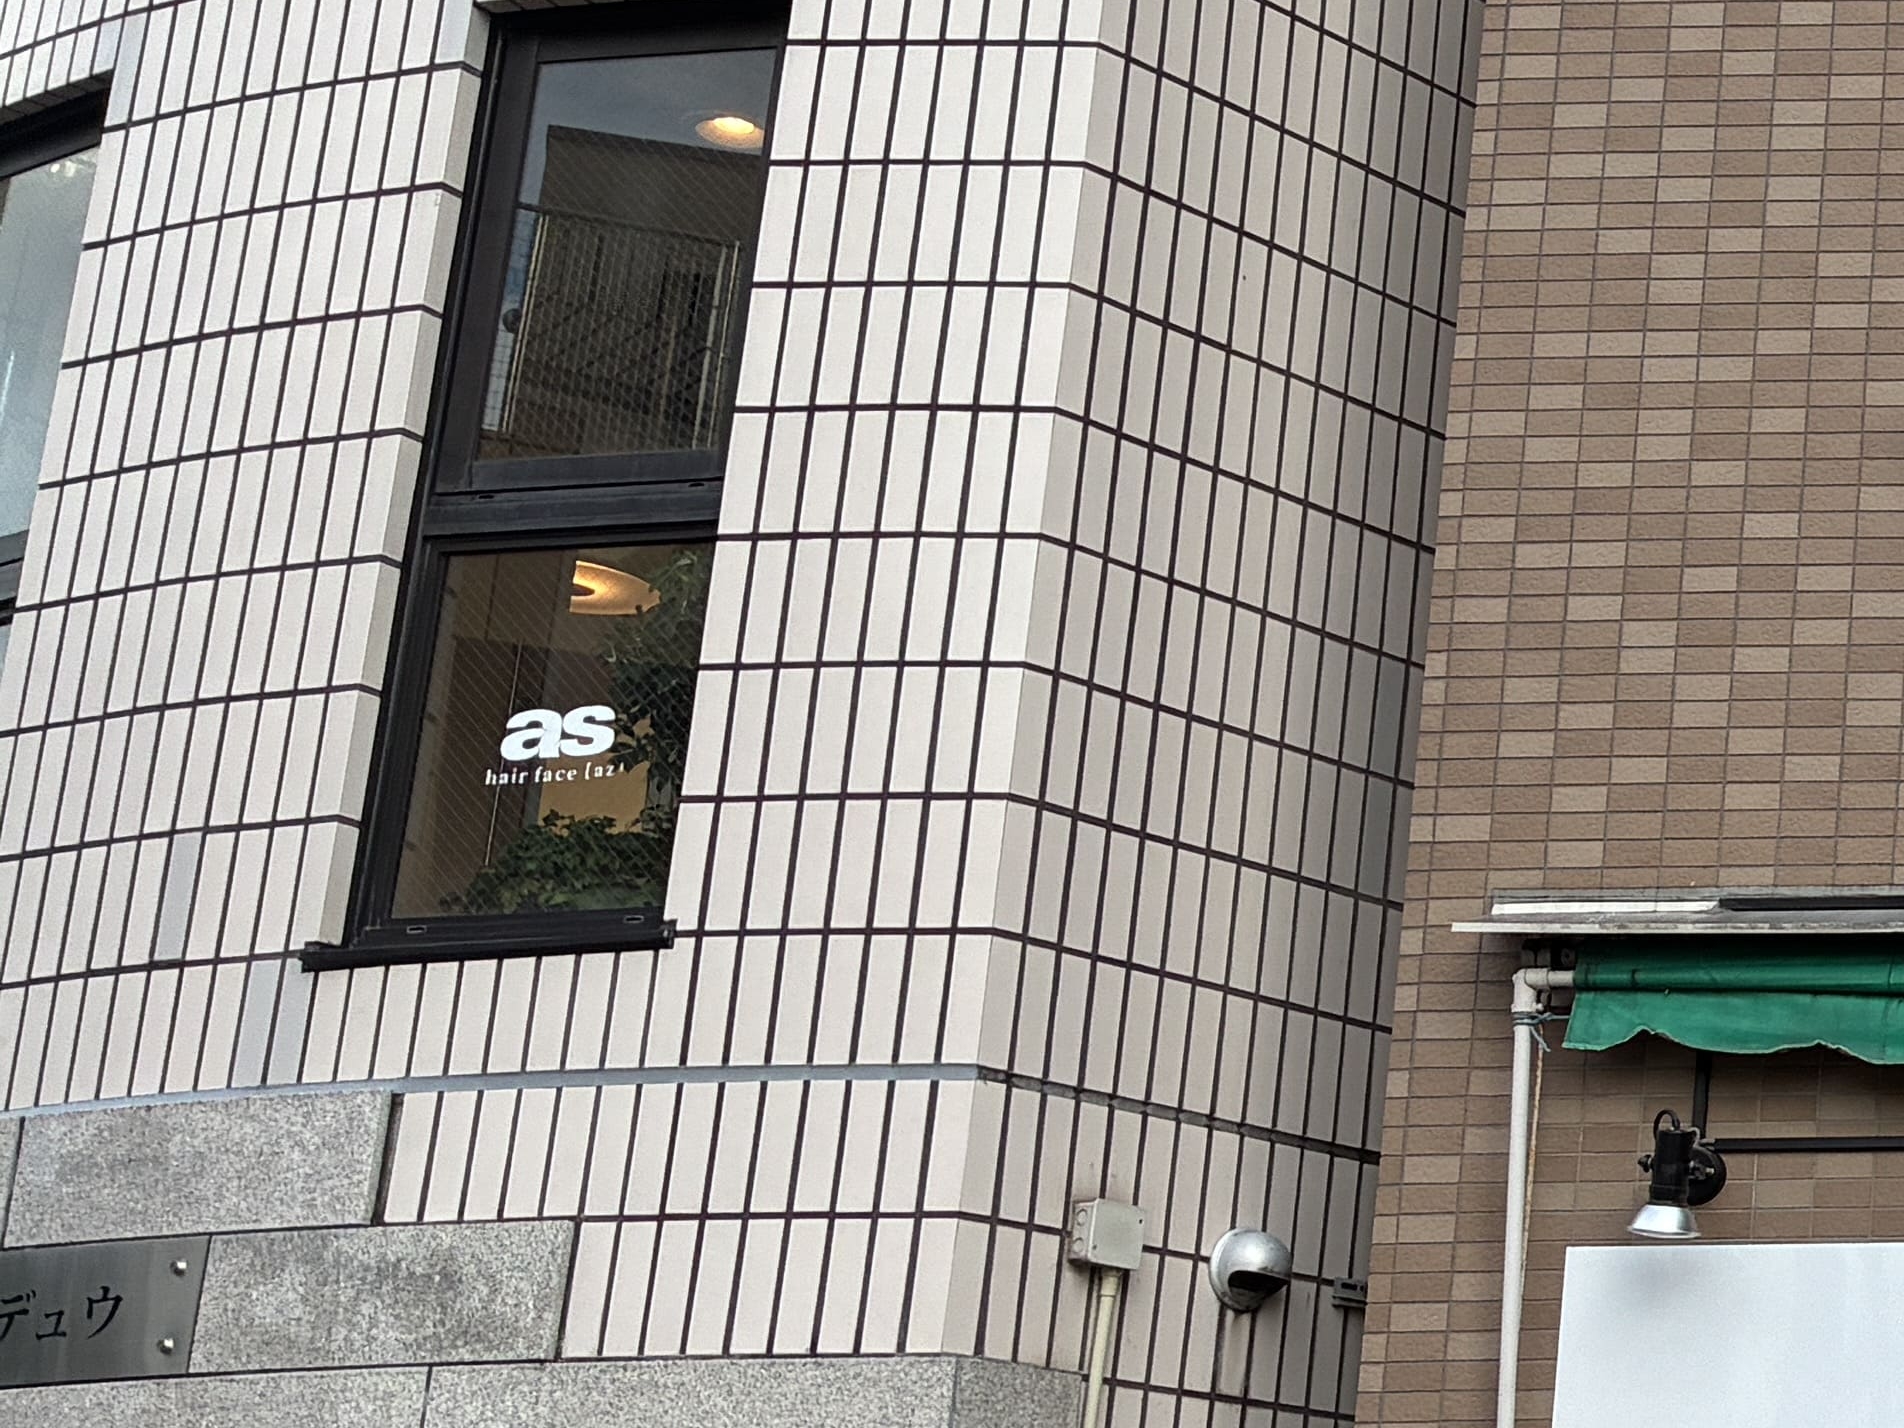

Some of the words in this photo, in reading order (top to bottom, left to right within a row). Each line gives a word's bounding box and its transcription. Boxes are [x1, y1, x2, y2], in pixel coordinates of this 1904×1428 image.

[500, 705, 616, 762] as
[485, 767, 528, 786] hair
[534, 766, 577, 783] face
